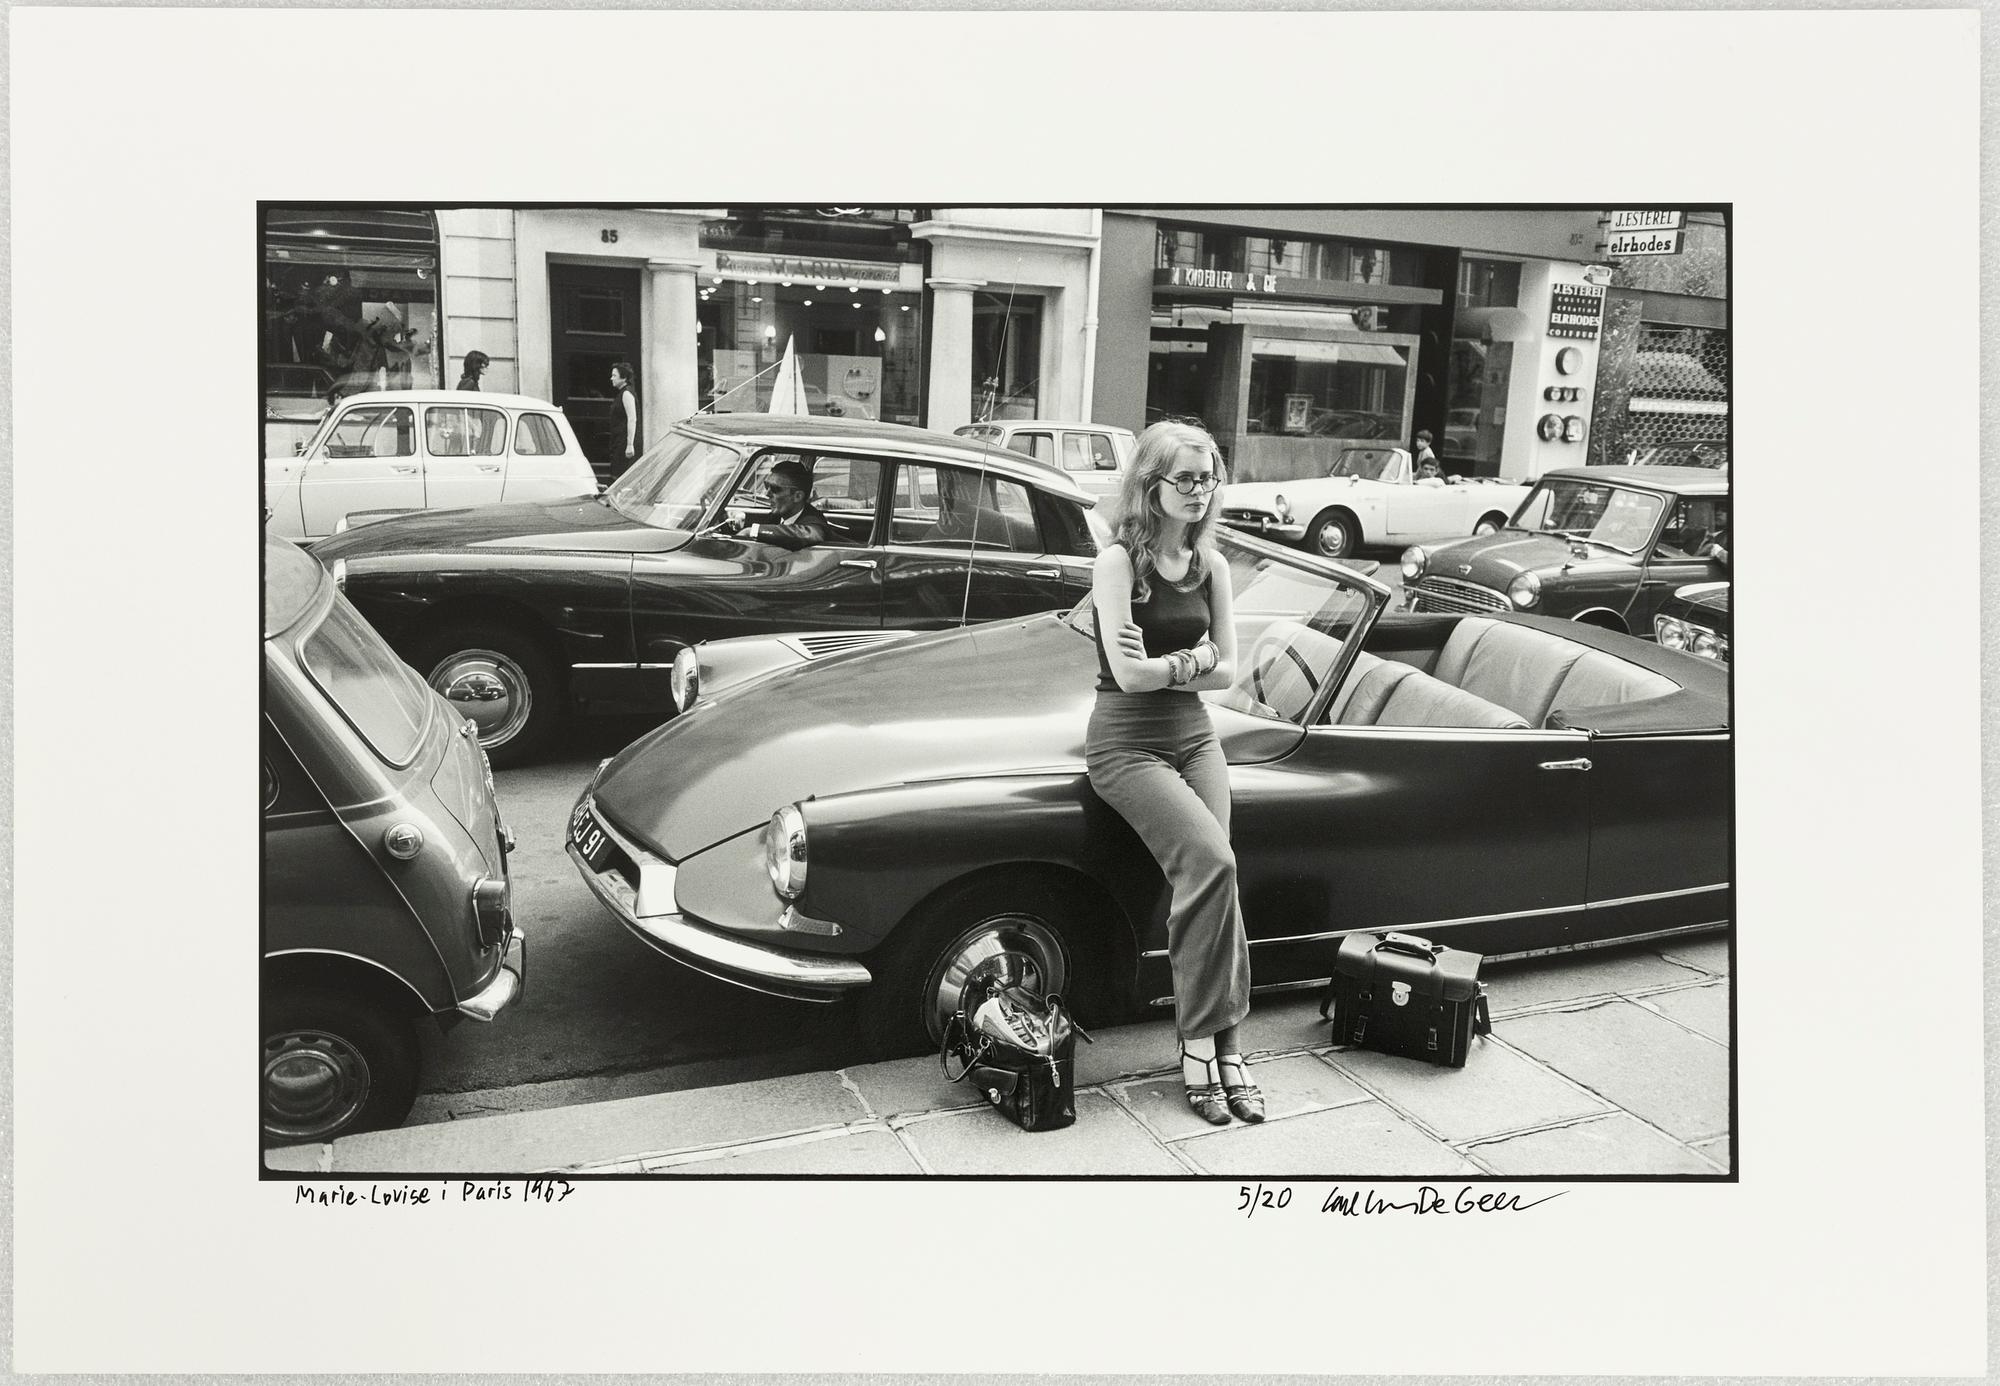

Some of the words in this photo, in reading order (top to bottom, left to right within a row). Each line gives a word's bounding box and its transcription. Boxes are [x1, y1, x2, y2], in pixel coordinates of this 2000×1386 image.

[1616, 211, 1673, 227] J.ESTEREL
[601, 229, 618, 243] 85
[1611, 235, 1672, 253] elrhodes
[1246, 273, 1256, 291] &
[1551, 312, 1600, 326] ELRHODES
[441, 1180, 447, 1201] i
[463, 1181, 511, 1201] Paris
[524, 1180, 575, 1203] 1967
[1238, 1184, 1292, 1218] 5/20
